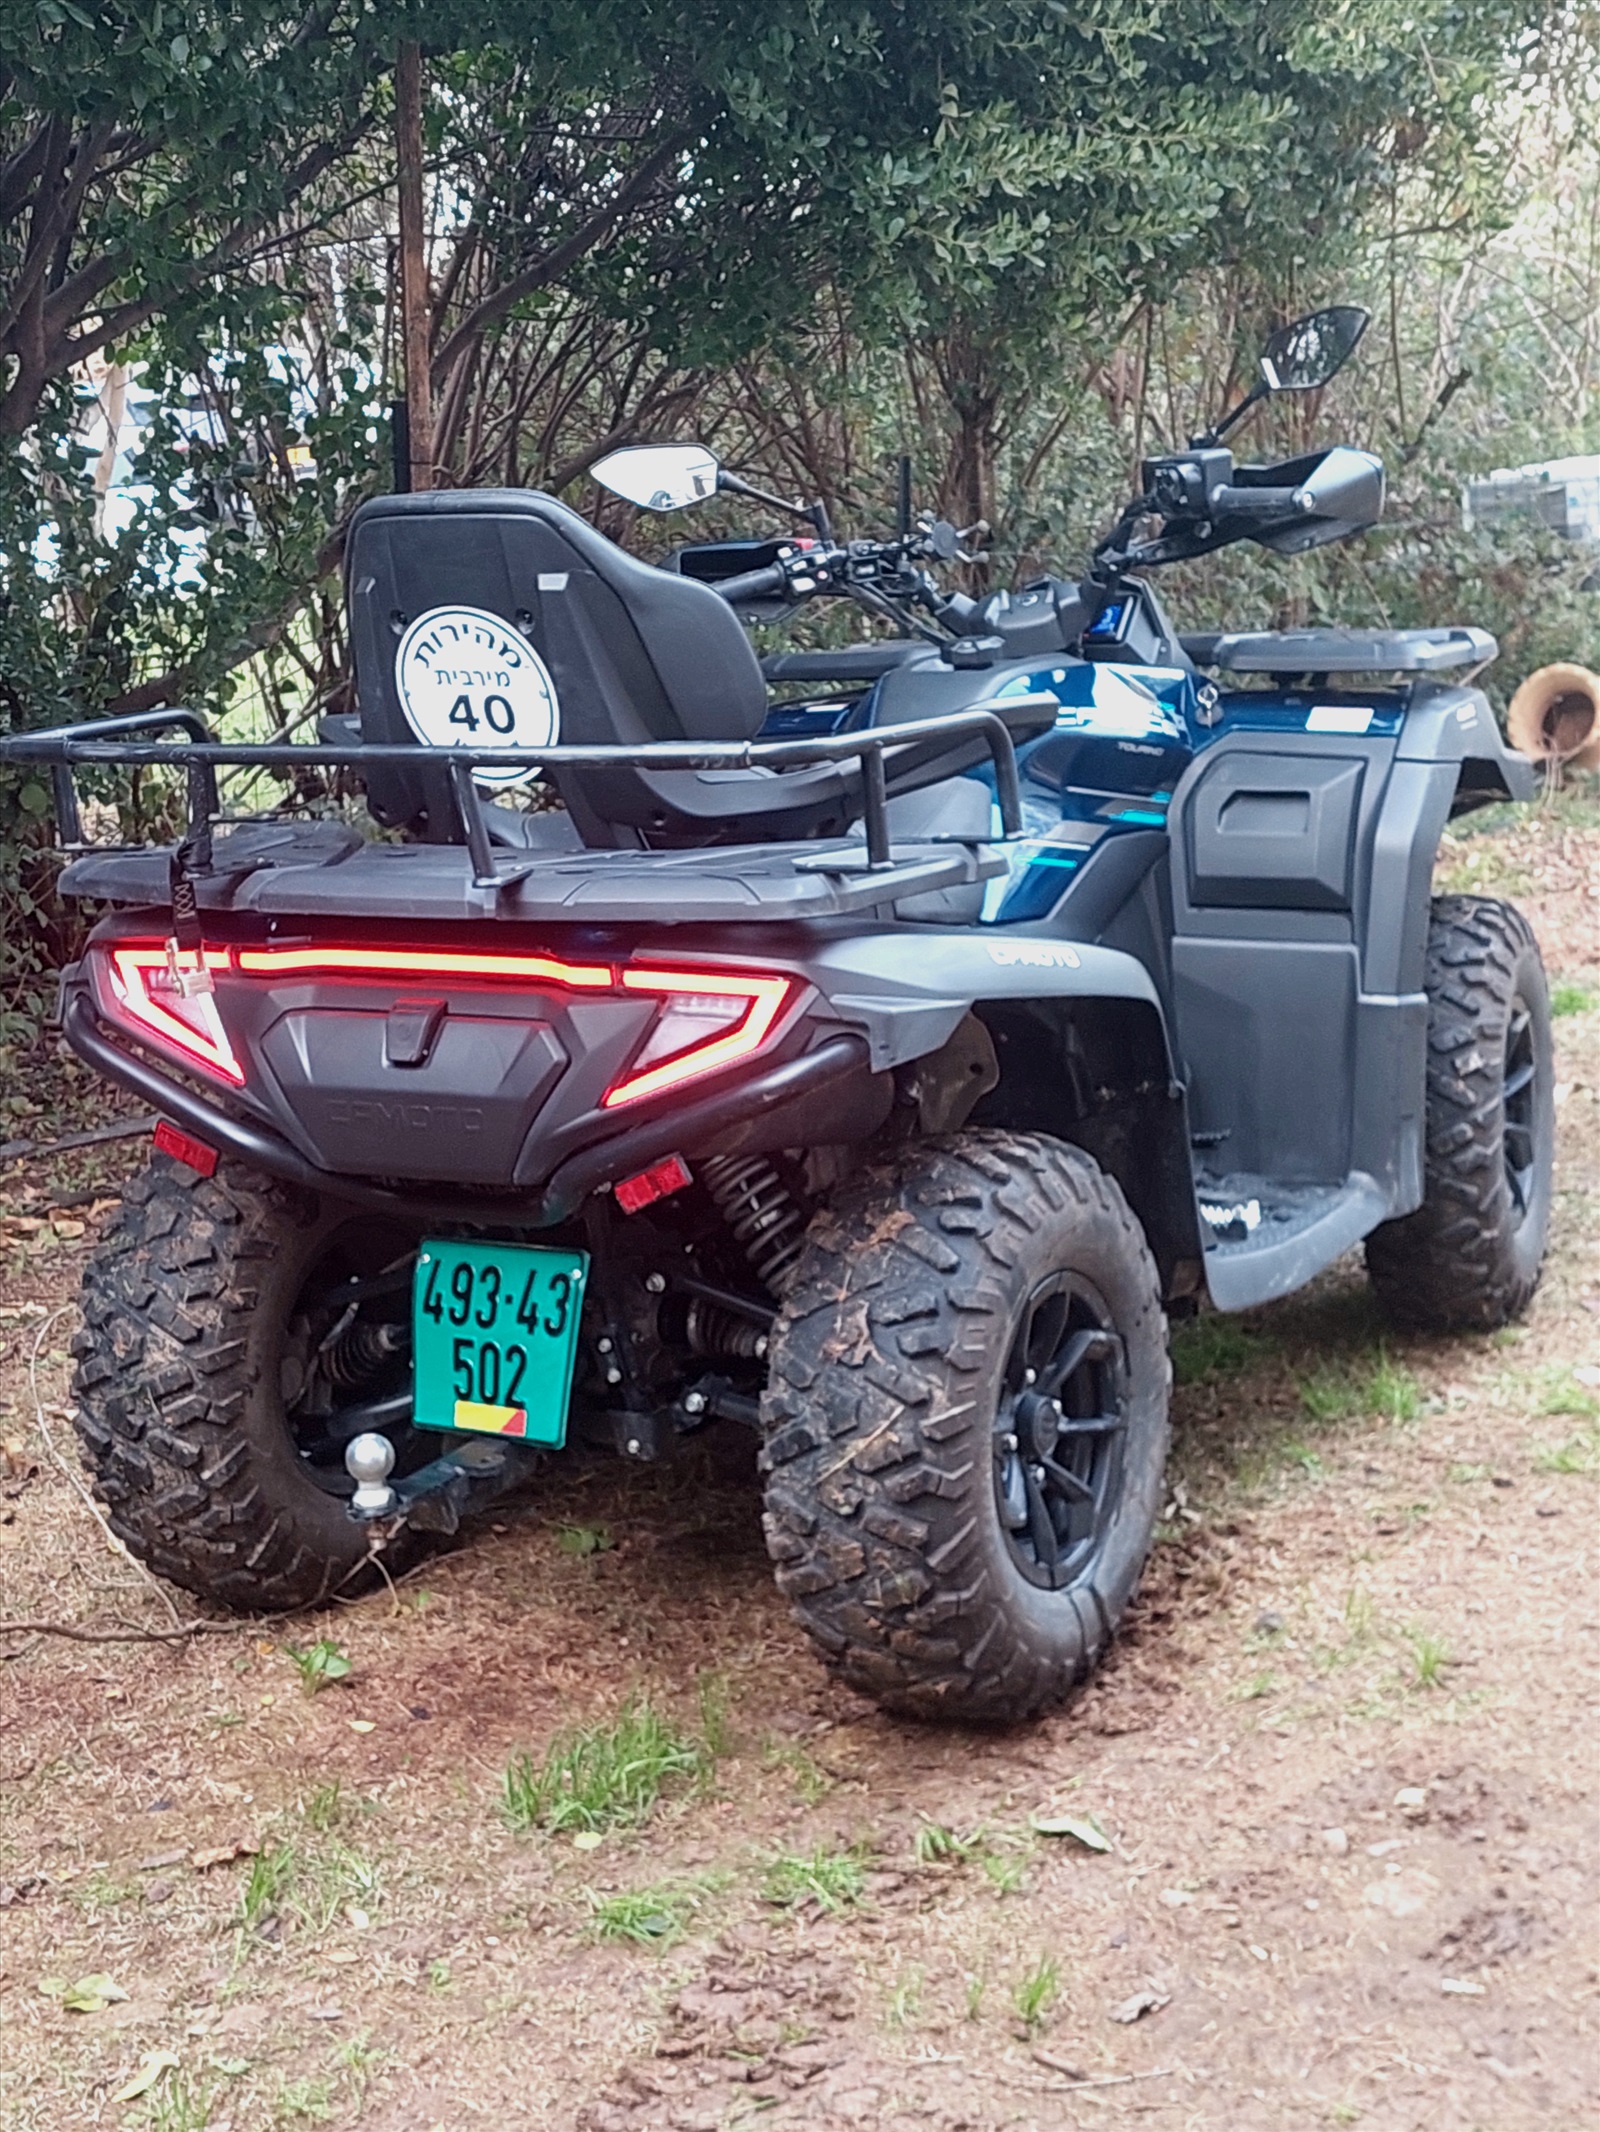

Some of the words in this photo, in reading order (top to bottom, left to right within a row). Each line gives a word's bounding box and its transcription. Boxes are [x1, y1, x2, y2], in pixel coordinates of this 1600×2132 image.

[413, 623, 522, 669] מהירות
[434, 670, 511, 687] מירבית
[448, 694, 516, 734] 40
[453, 1337, 528, 1409] 502
